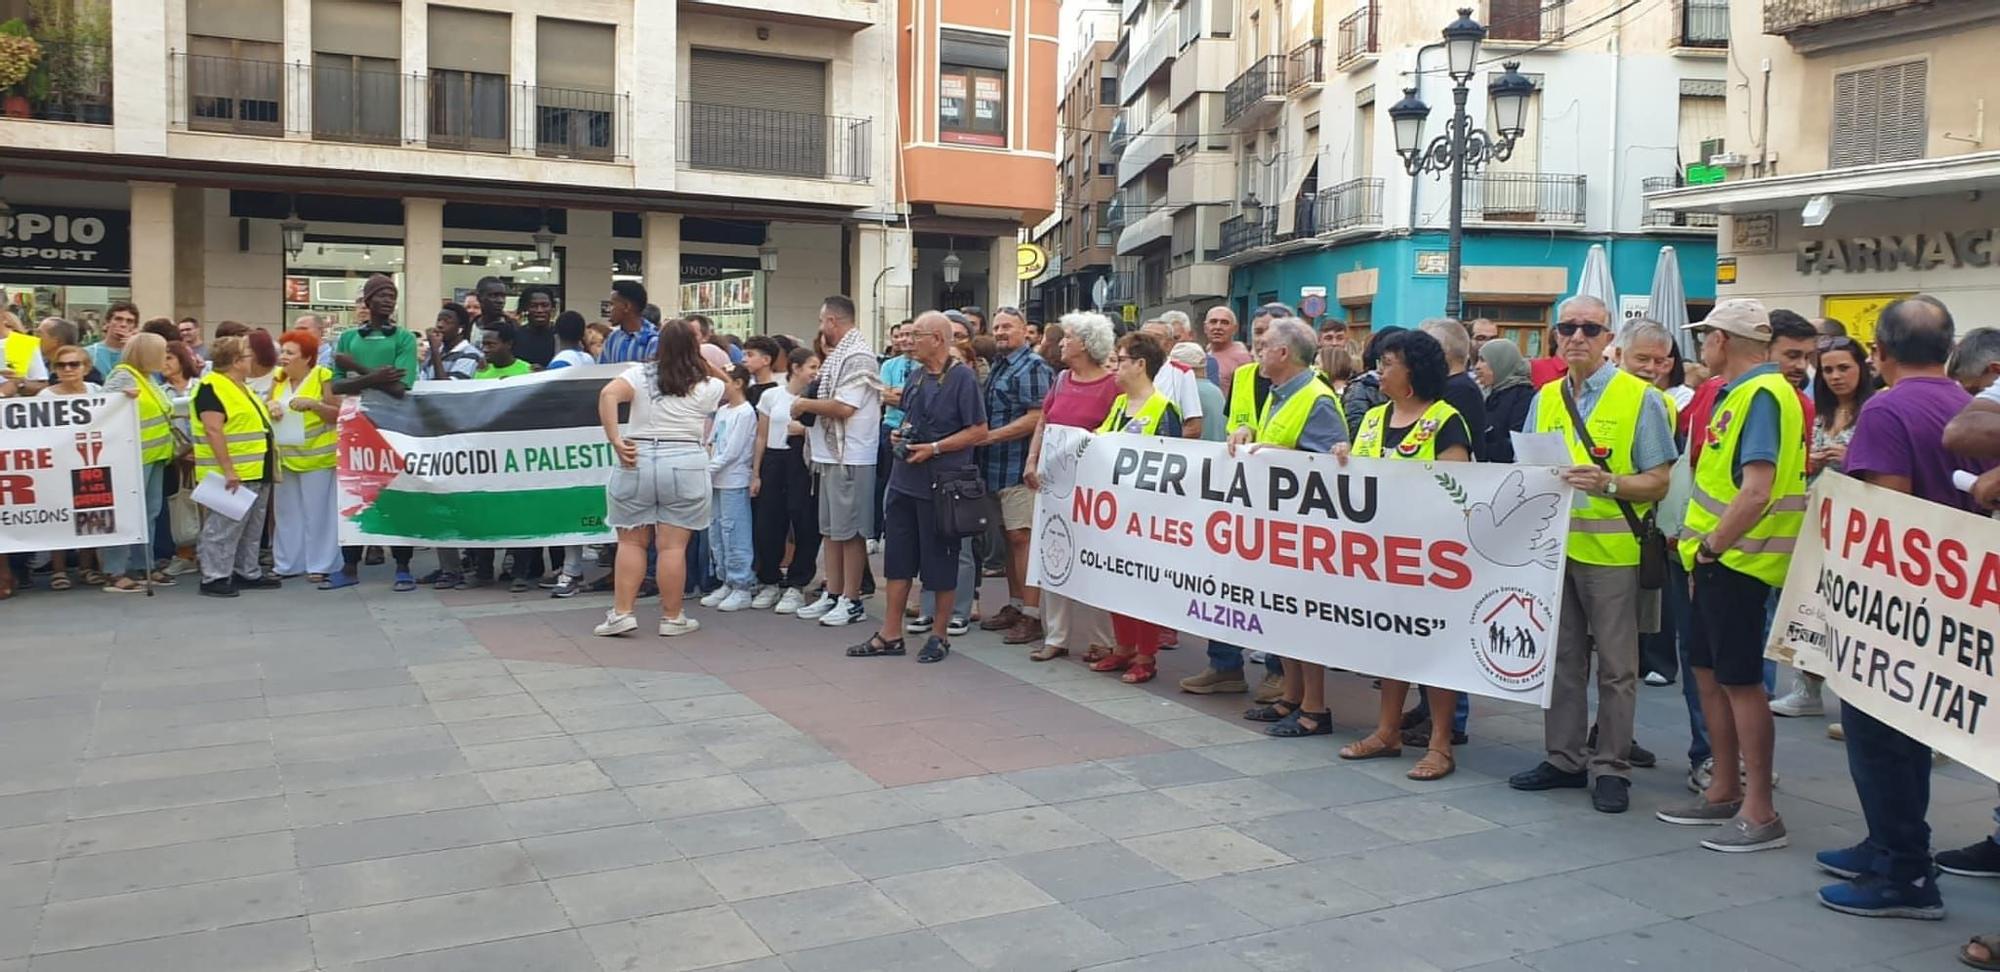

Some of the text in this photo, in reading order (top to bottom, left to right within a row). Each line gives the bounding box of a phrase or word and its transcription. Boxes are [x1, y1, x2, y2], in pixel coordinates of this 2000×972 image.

[2, 246, 98, 260] SPORT
[0, 398, 106, 430] GNES”
[350, 447, 374, 471] NO
[379, 448, 399, 473] AL
[404, 449, 497, 477] GENOCIDI
[504, 449, 520, 473] A
[1112, 447, 1378, 524] PER LA PAU
[0, 507, 70, 525] ENSIONS
[1072, 486, 1473, 590] NO A LES GUERRES
[1187, 599, 1264, 635] ALZIRA
[1220, 582, 1255, 607] PER
[1260, 591, 1298, 614] LES
[1304, 600, 1446, 637] PENSIONS”
[1938, 614, 1995, 677] PER
